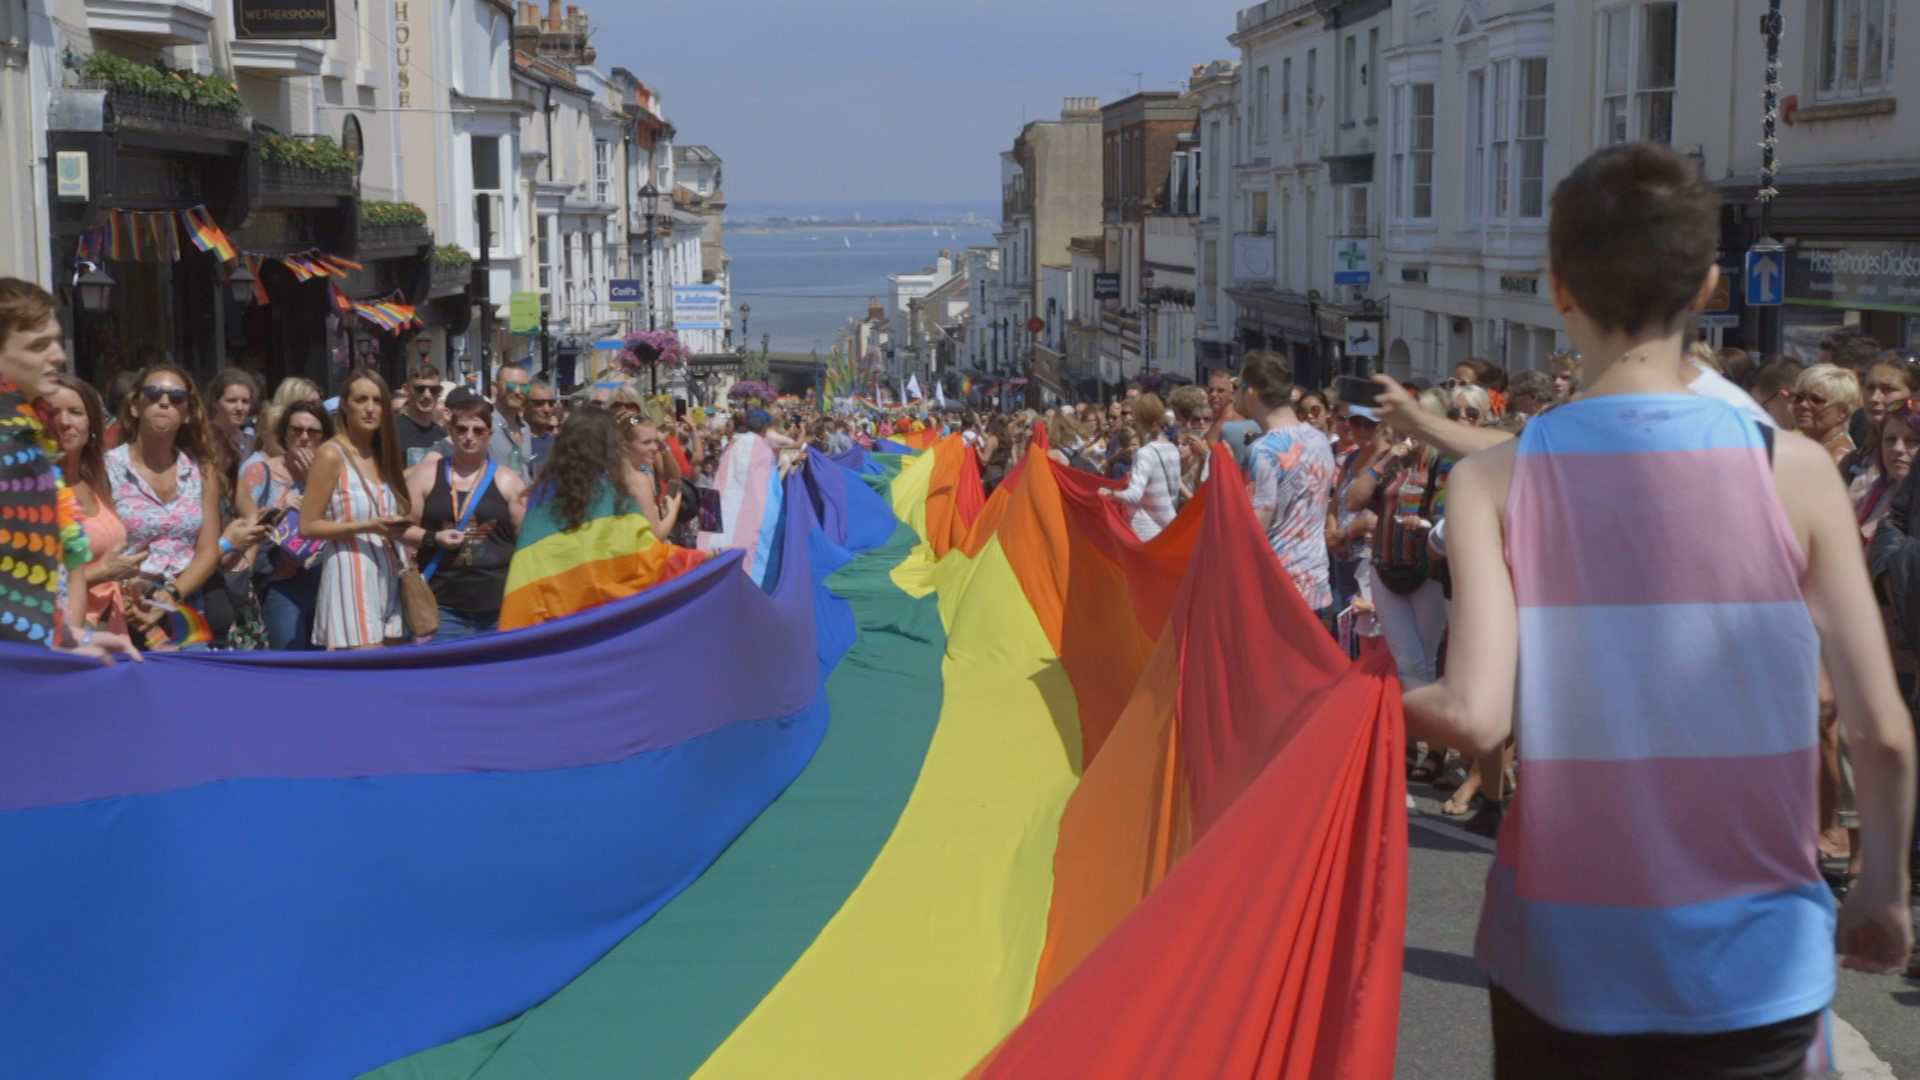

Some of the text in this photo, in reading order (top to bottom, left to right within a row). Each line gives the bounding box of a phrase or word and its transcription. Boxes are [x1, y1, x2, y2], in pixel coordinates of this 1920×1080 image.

[245, 9, 325, 20] WETHERSPOON
[1809, 248, 1920, 277] Hose Rhodes Dickso
